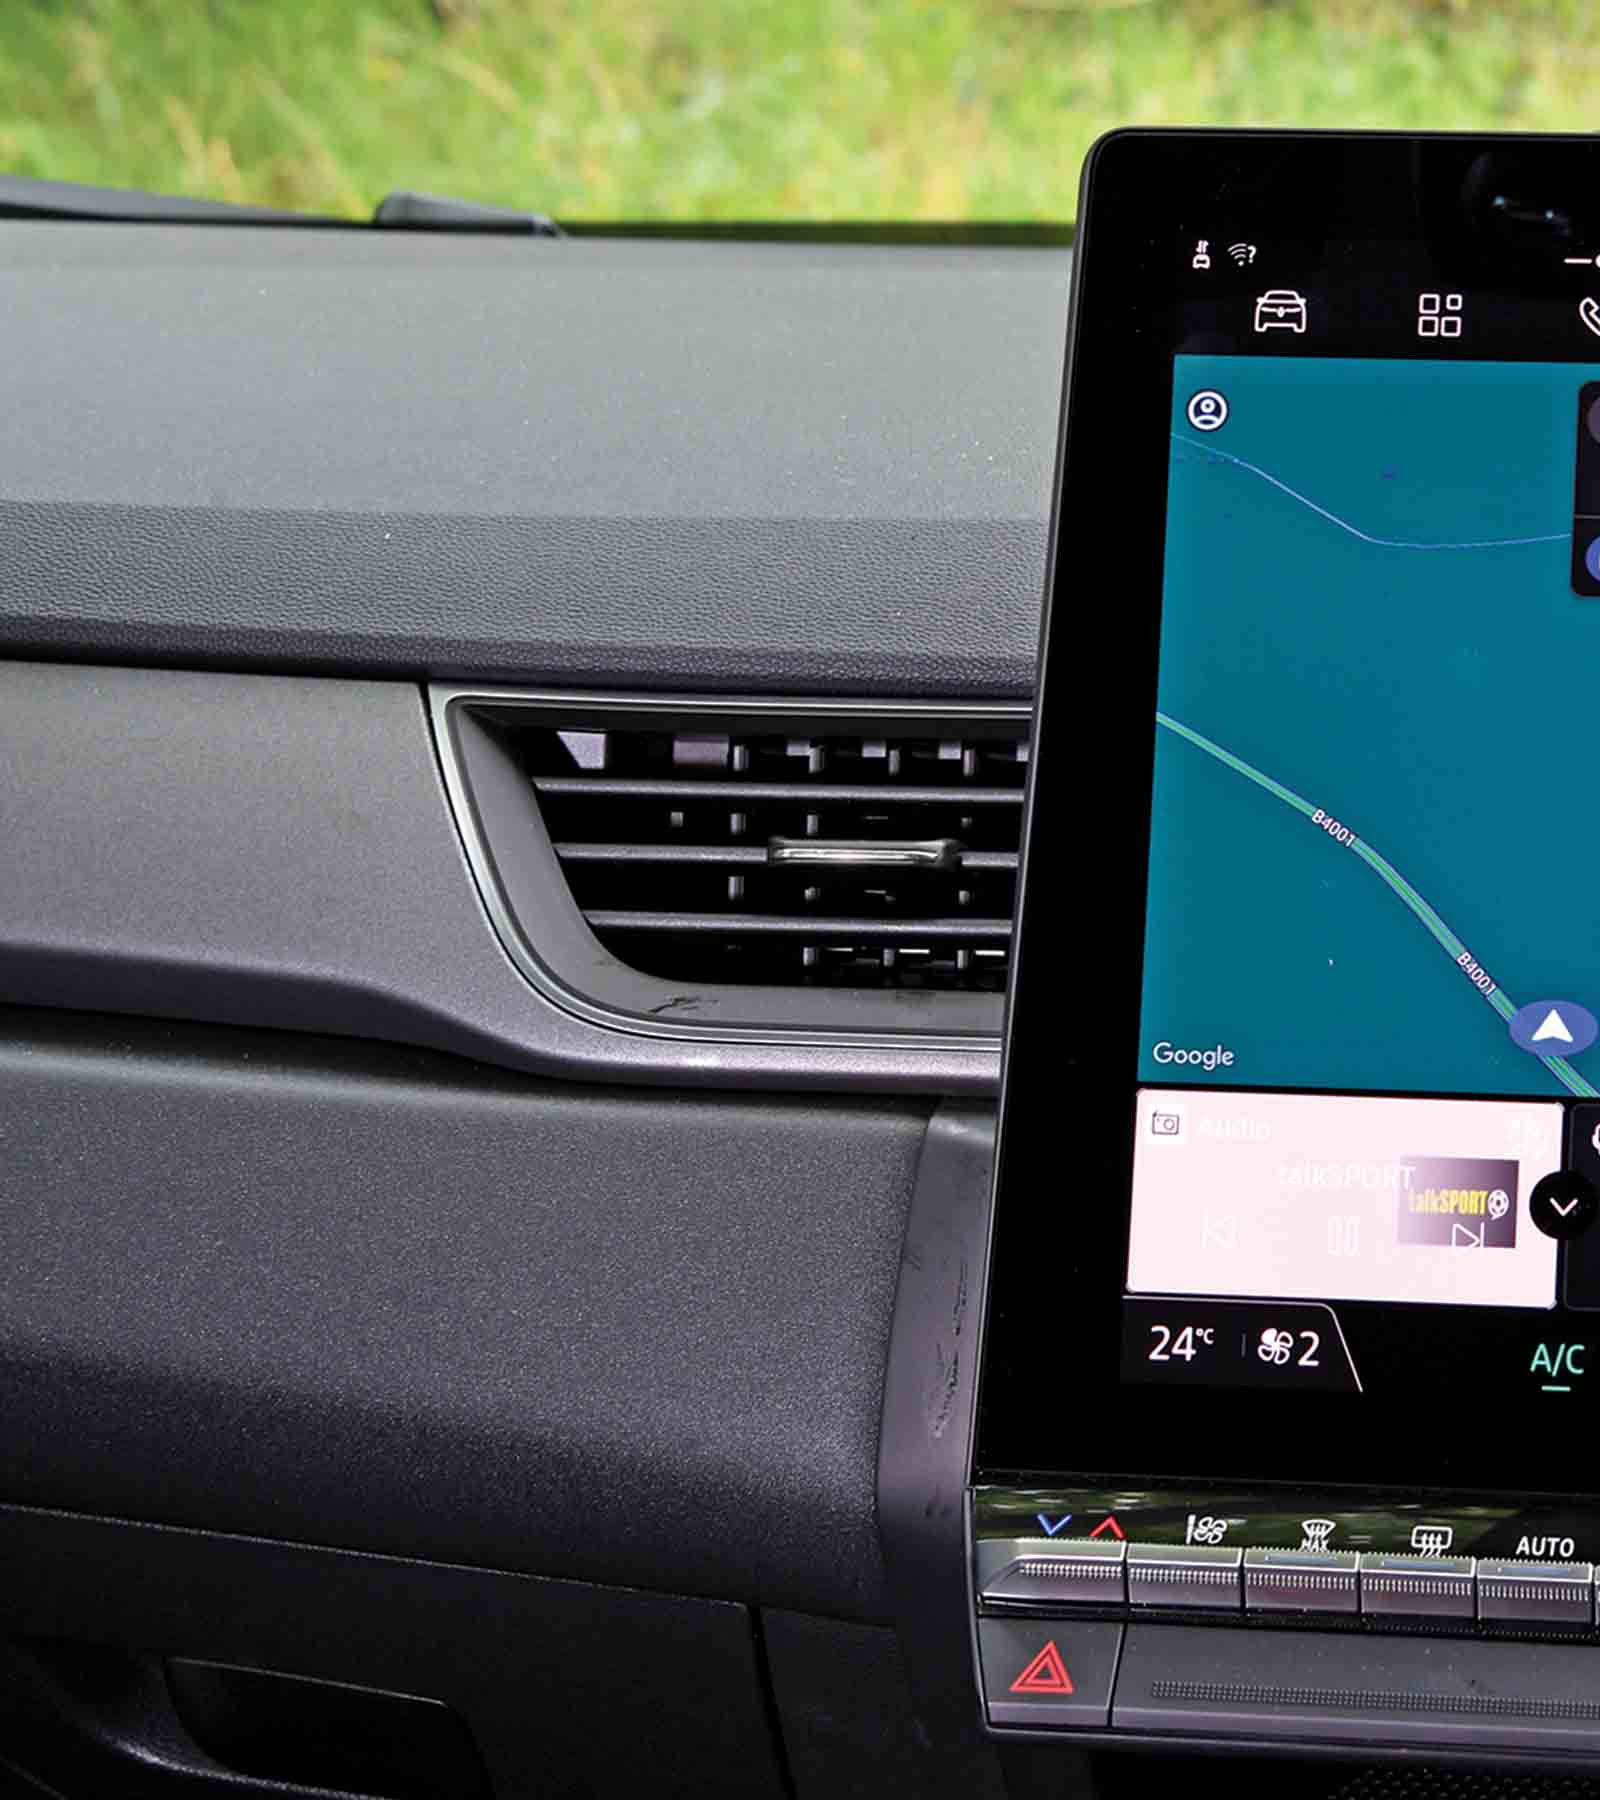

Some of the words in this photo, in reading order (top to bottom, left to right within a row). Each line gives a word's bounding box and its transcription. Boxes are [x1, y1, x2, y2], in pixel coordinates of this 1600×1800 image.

[1311, 809, 1356, 847] B4001
[1456, 951, 1497, 996] B4001
[1152, 1042, 1235, 1070] Google
[1196, 1115, 1271, 1141] Audio
[1278, 1162, 1416, 1189] talkSPORT
[1408, 1188, 1488, 1216] talkSPORT
[1297, 1330, 1321, 1367] 2
[1530, 1342, 1586, 1377] A/C
[1516, 1535, 1575, 1558] AUTO
